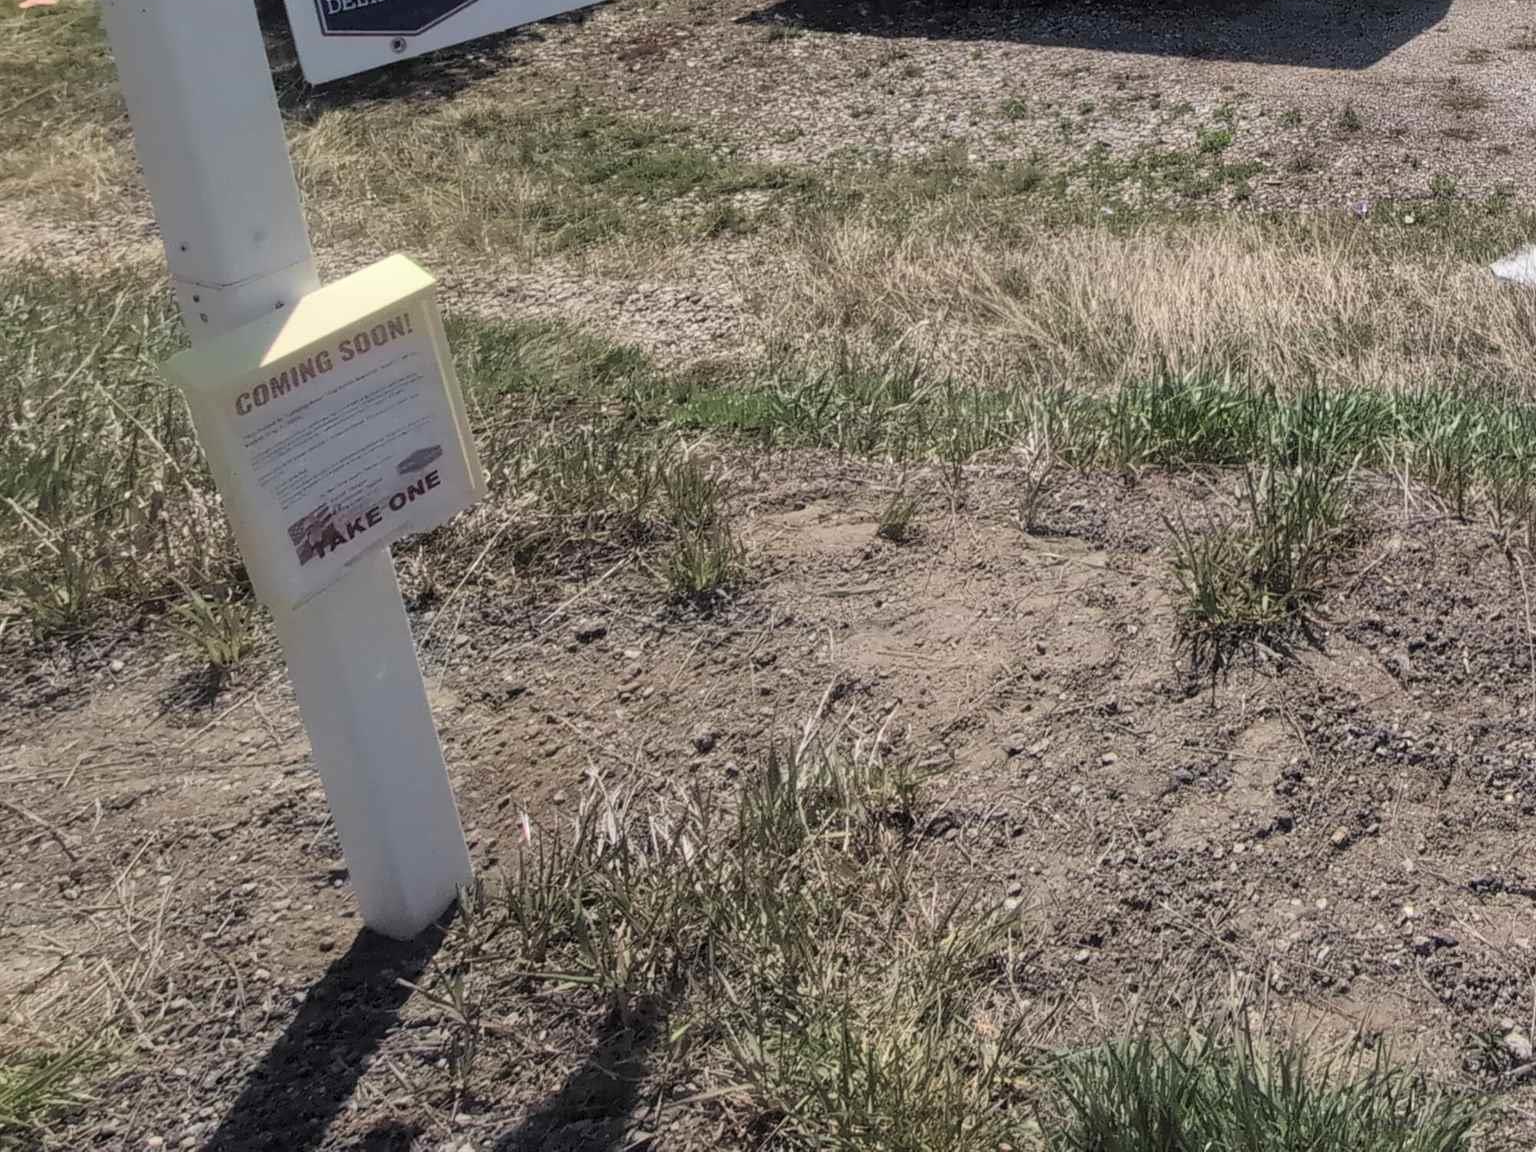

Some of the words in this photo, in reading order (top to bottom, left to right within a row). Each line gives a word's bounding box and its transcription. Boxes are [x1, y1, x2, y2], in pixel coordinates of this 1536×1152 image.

[235, 350, 333, 416] COMING
[338, 312, 414, 363] SOON!
[310, 506, 383, 559] TAKE
[388, 469, 441, 511] ONE
